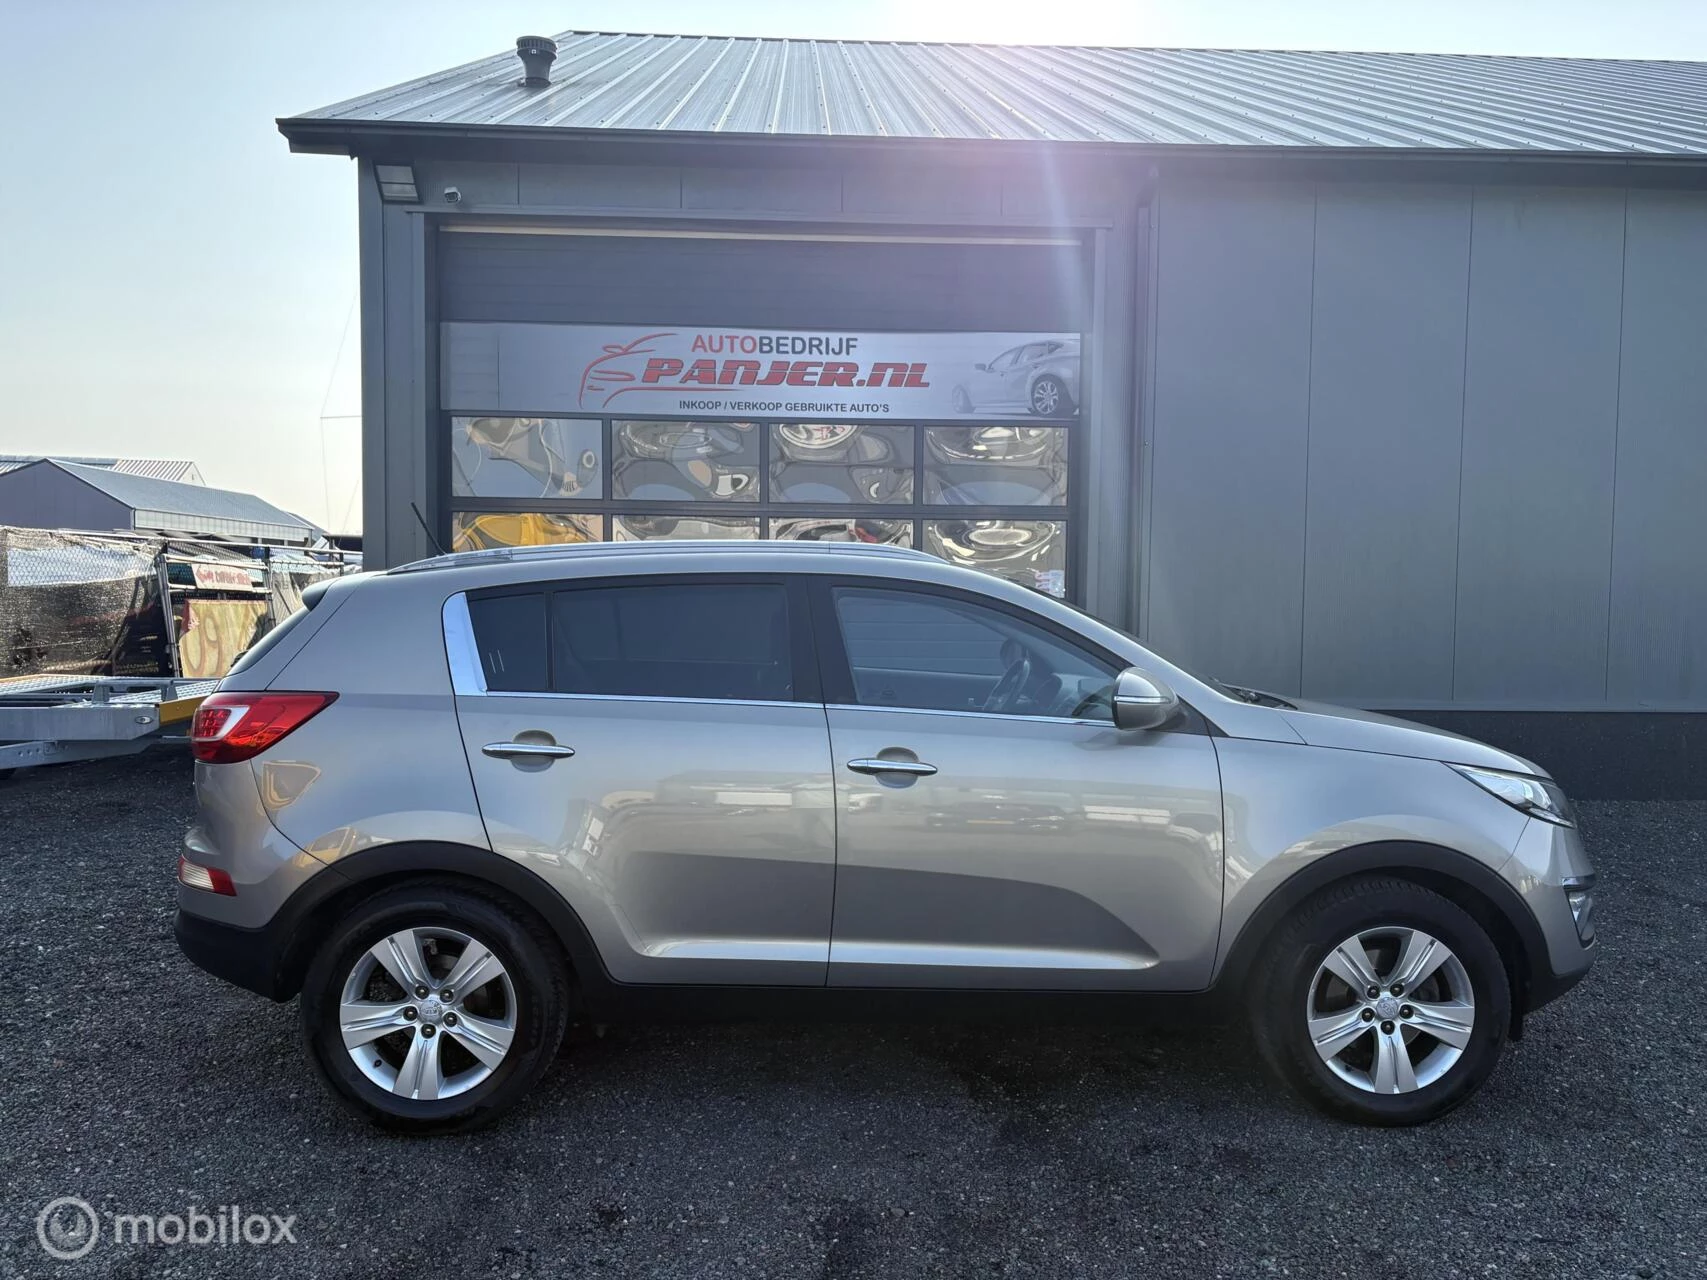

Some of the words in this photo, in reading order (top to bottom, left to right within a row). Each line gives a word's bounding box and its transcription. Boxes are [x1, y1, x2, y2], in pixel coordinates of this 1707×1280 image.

[691, 334, 859, 356] AUTOBEDRIJF
[679, 400, 721, 410] INKOOP
[729, 401, 783, 412] VERKOOP
[785, 402, 847, 412] GEBRUIKTE
[849, 403, 890, 413] AUTO'S
